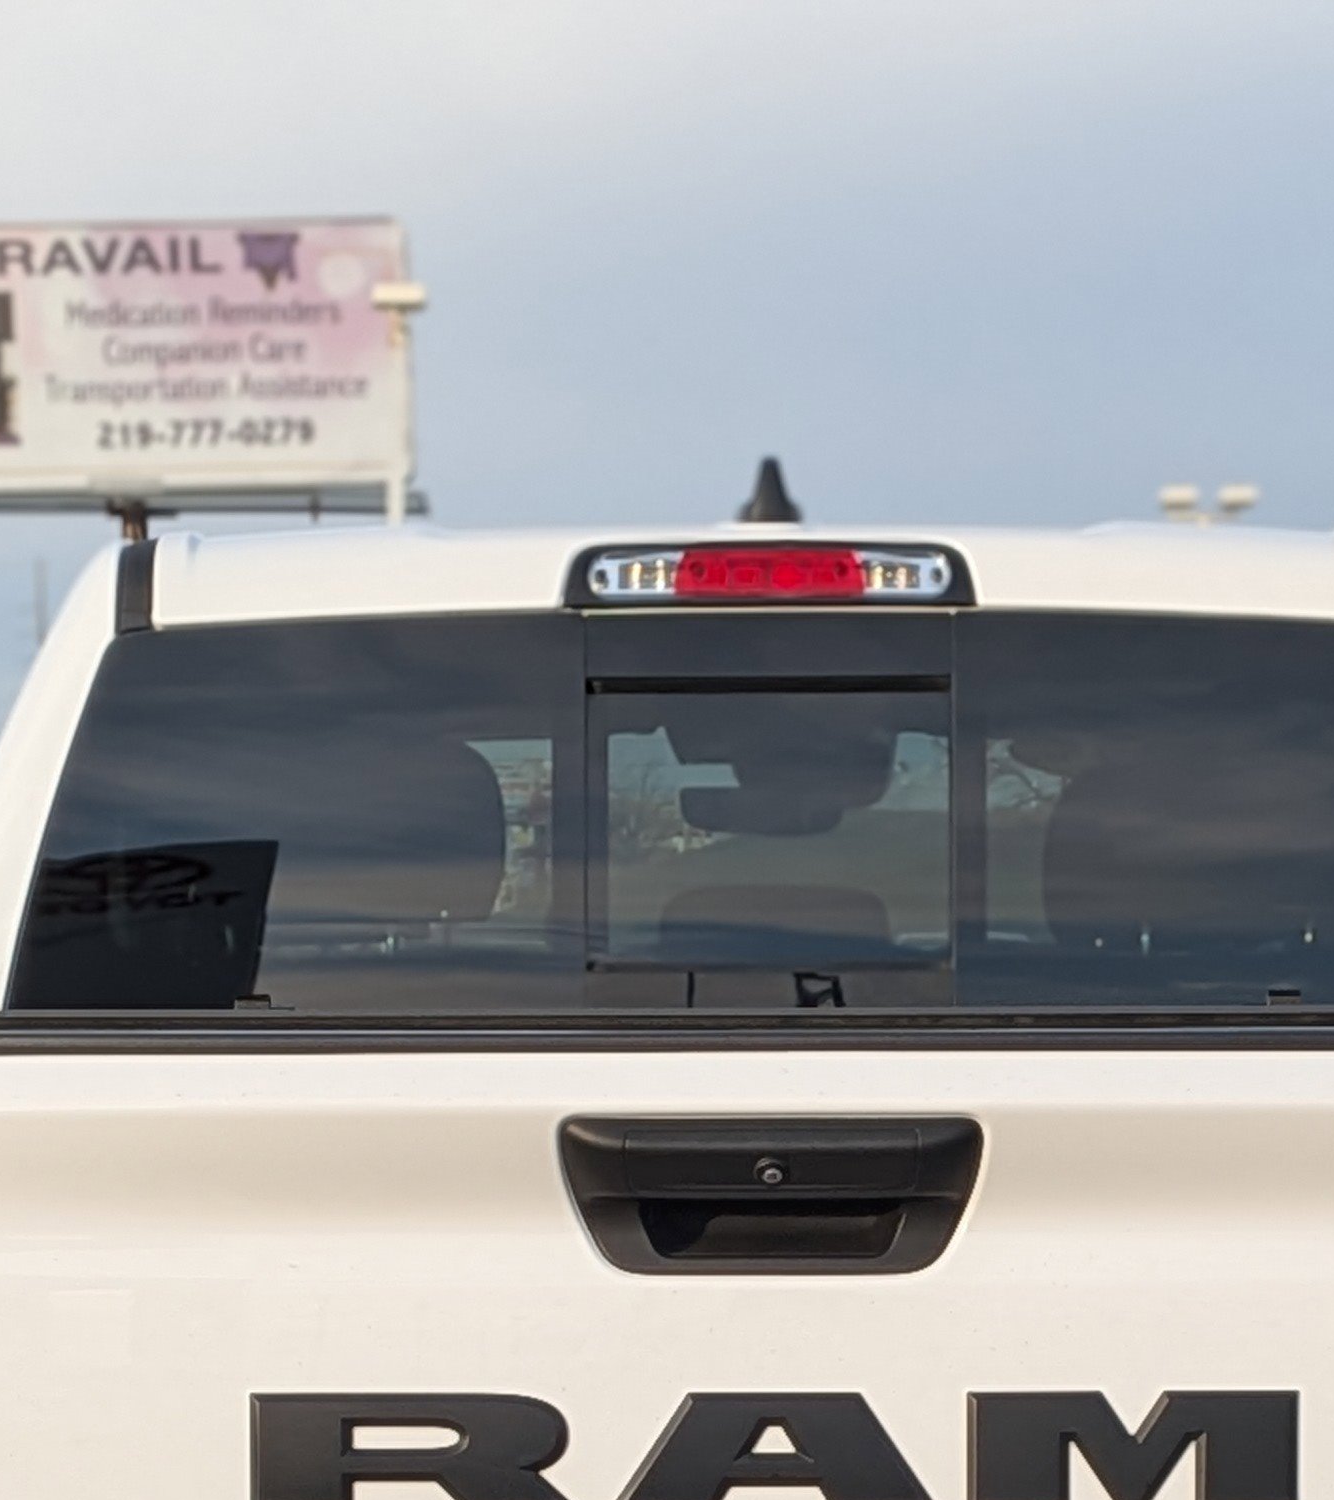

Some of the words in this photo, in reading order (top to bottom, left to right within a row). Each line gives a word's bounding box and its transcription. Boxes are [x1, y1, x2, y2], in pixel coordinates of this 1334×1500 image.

[64, 300, 202, 326] Medication
[208, 297, 341, 325] Reminders
[101, 334, 242, 368] Companion
[249, 332, 307, 362] Care
[45, 373, 229, 407] Transportation
[237, 373, 369, 400] Assistance
